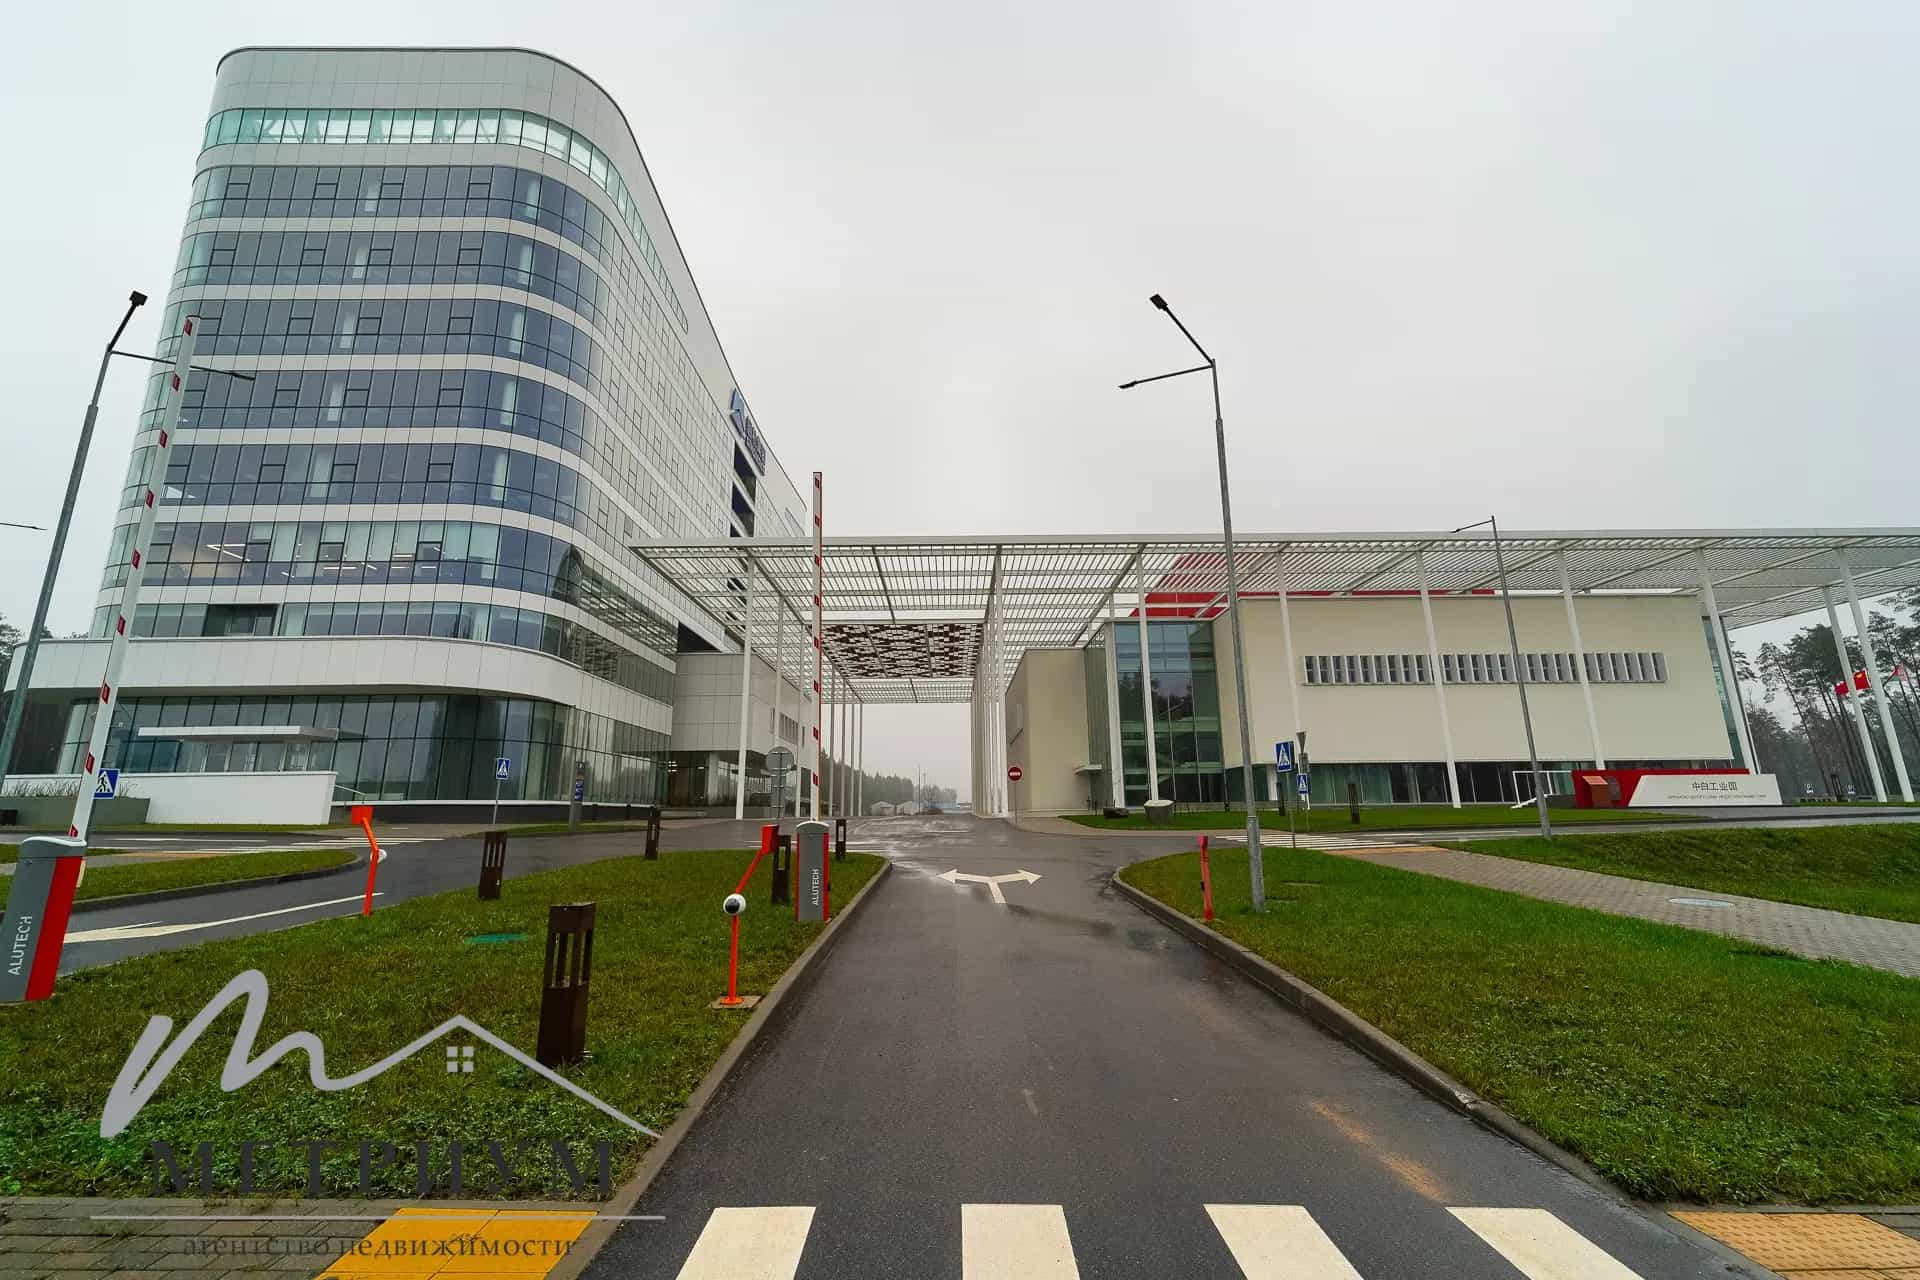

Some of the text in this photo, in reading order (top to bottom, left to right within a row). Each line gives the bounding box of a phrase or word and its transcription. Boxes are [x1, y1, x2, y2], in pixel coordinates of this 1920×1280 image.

[1692, 781, 1738, 791] 中白工业园
[812, 868, 820, 906] ALUTECH
[8, 915, 33, 976] ALUTECH
